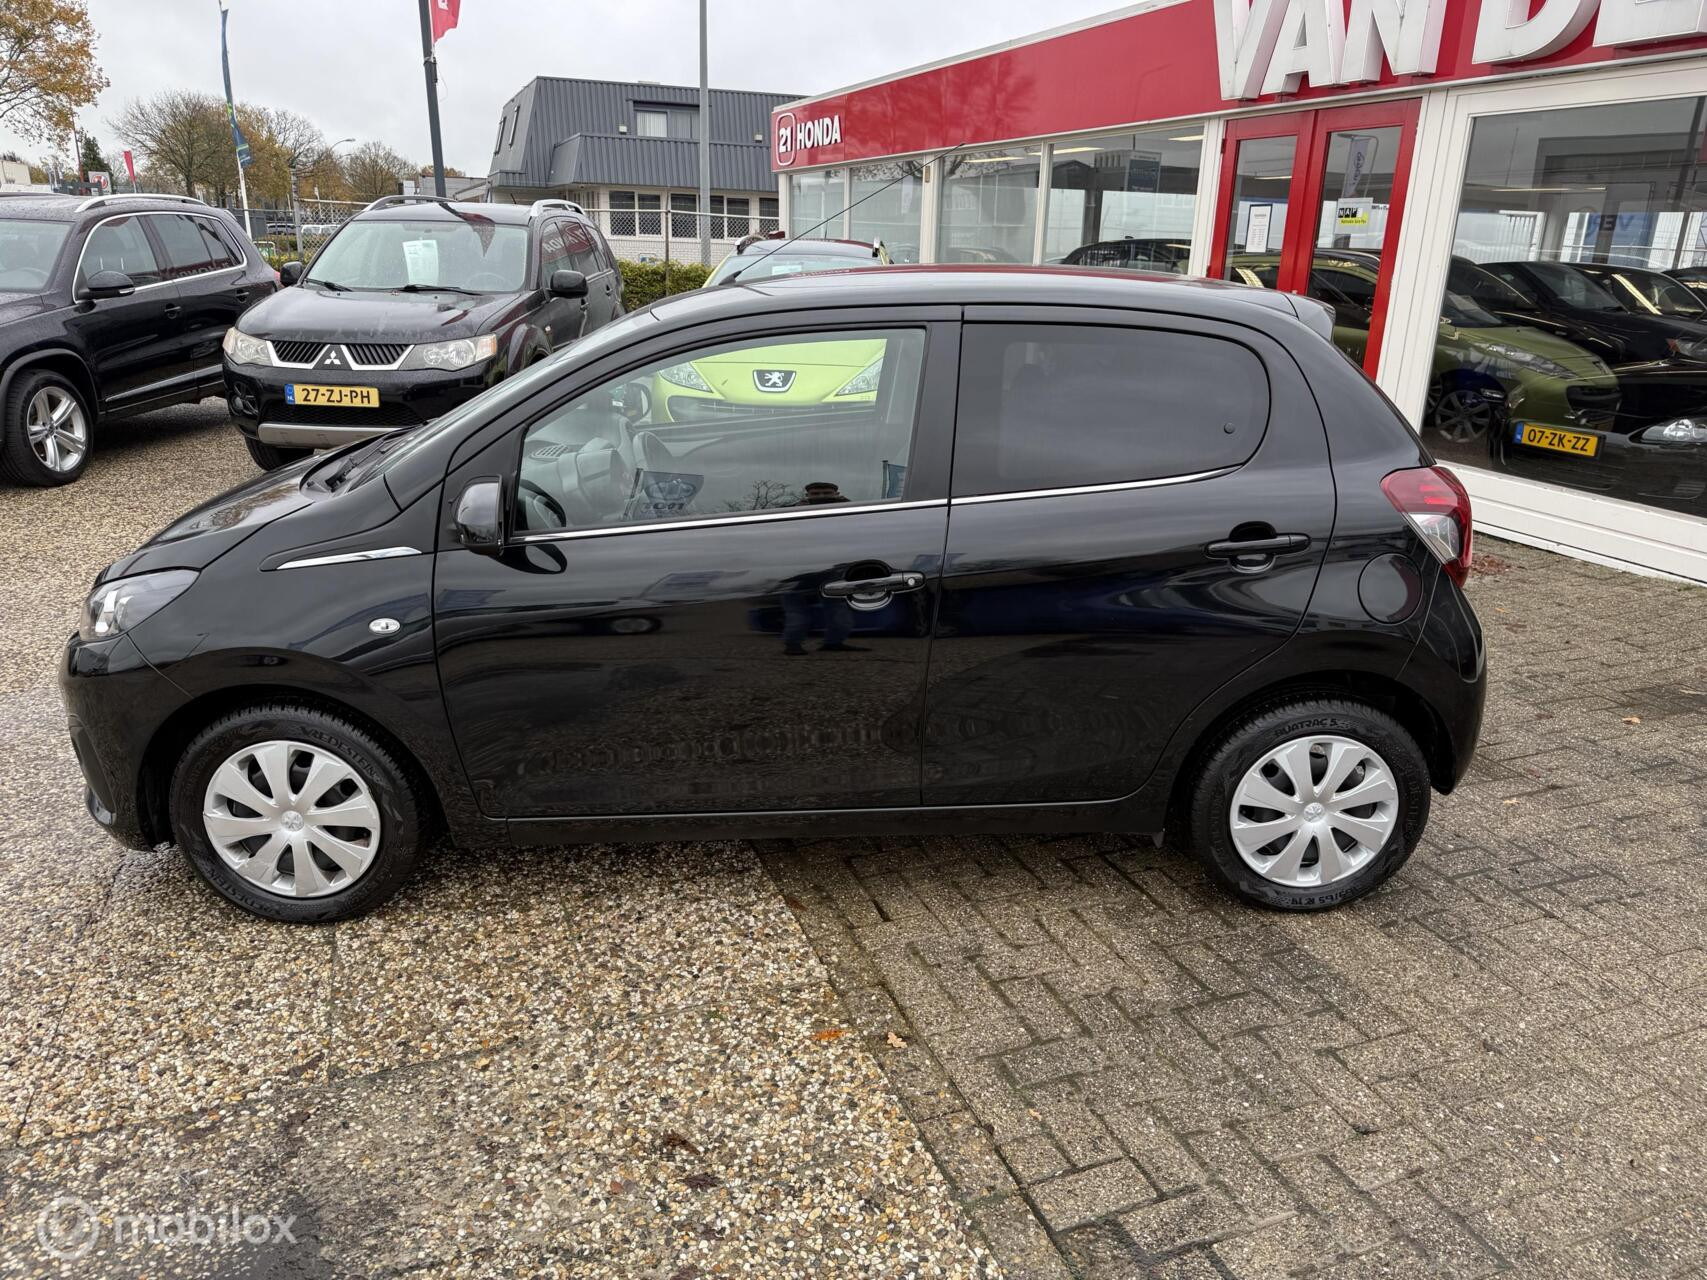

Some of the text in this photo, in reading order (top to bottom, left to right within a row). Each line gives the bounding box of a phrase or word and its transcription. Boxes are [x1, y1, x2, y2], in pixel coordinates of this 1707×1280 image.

[779, 114, 842, 153] 21 HONDA
[301, 387, 371, 404] 27-ZJ-PH
[1527, 428, 1591, 452] 07-ZK-ZZ
